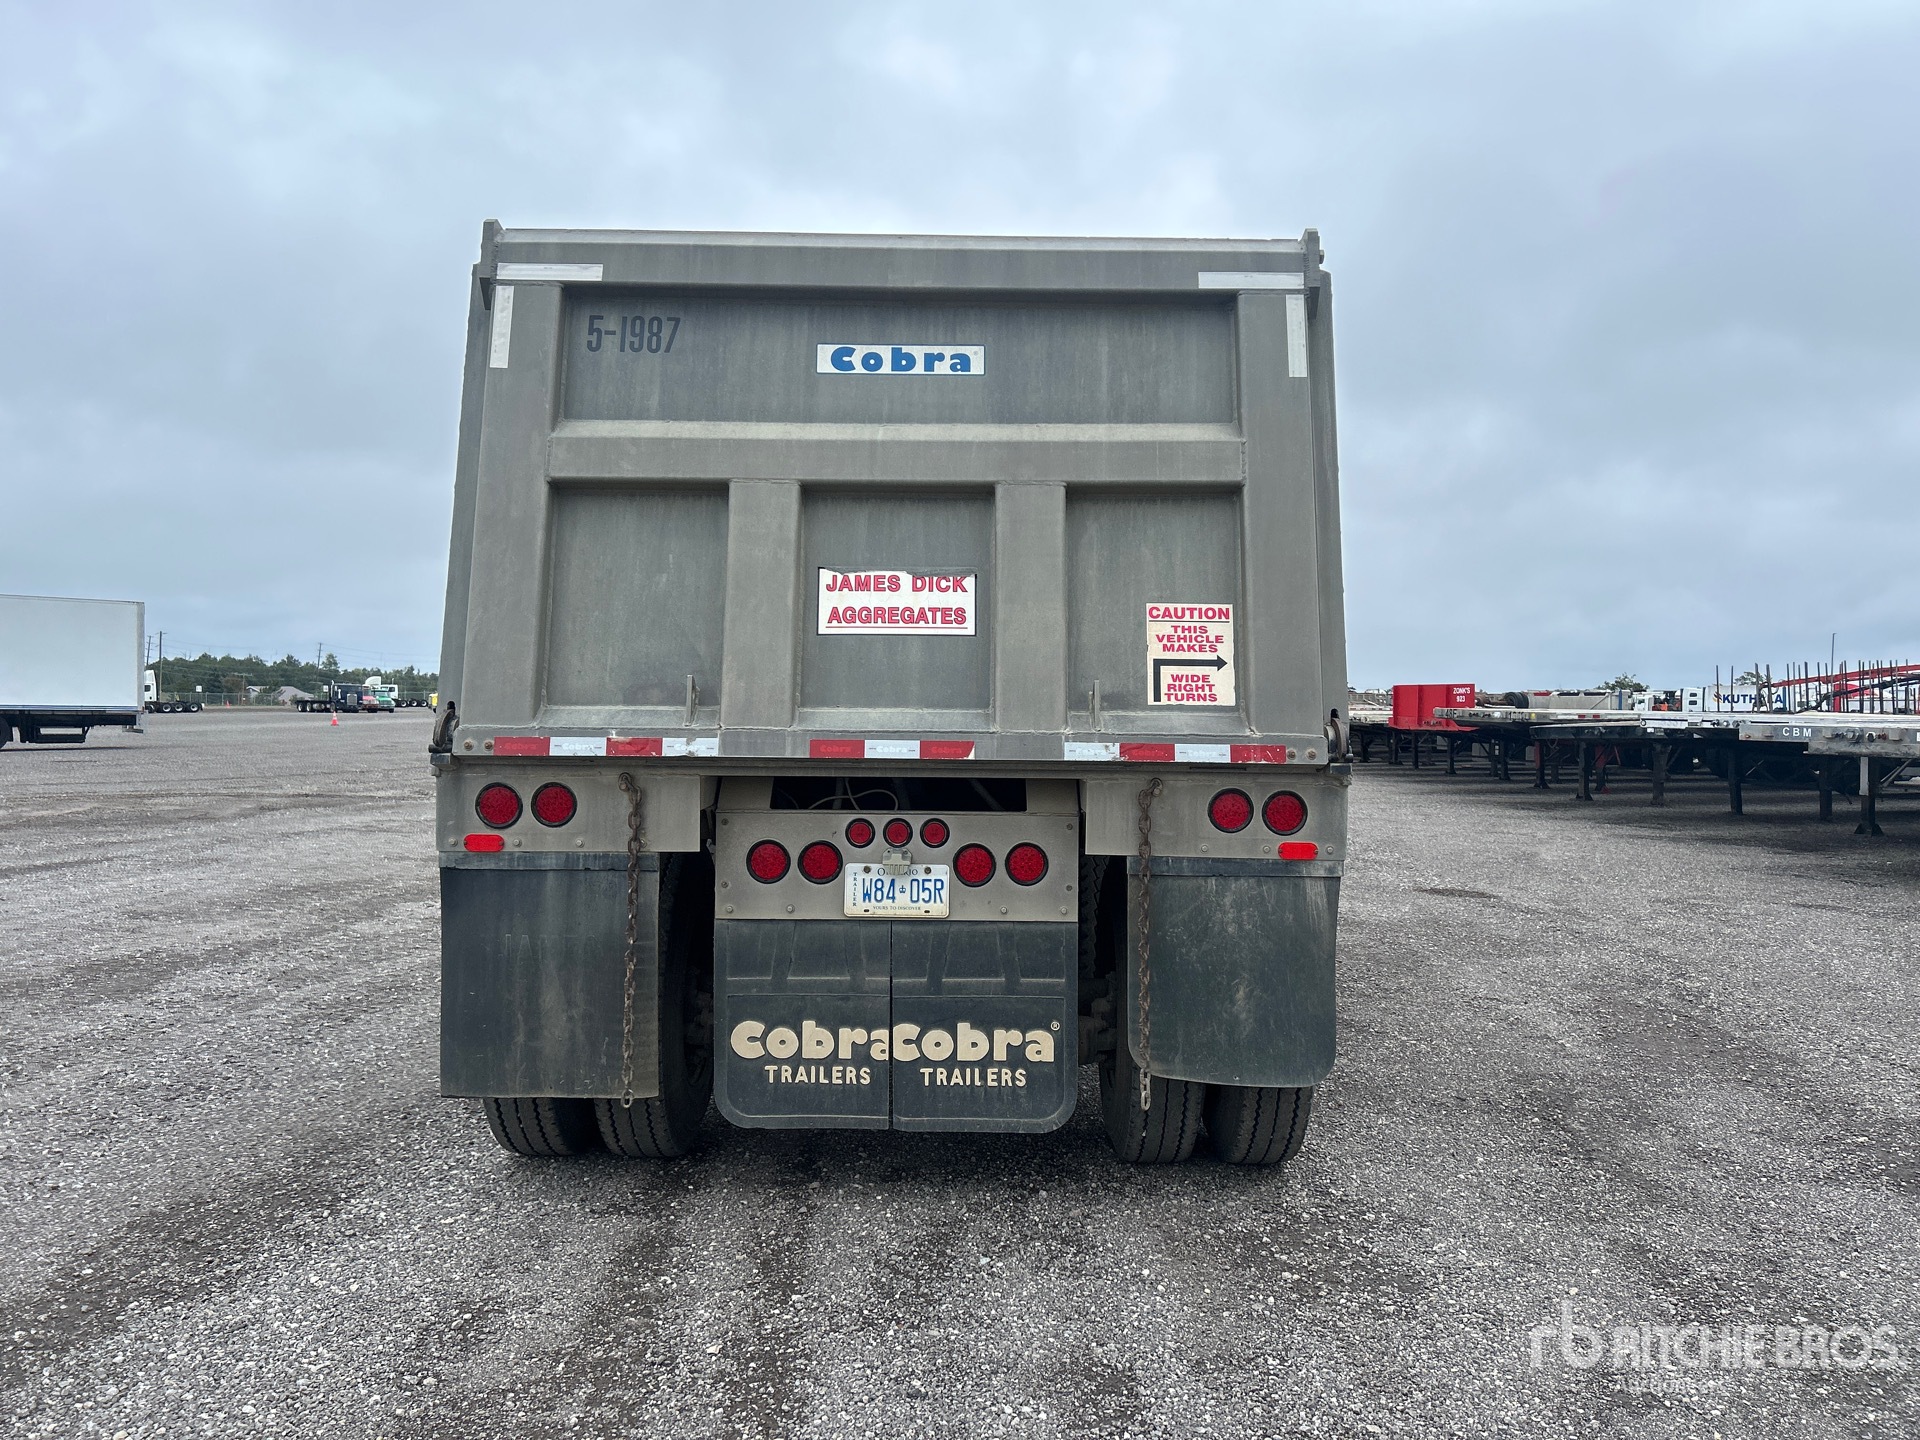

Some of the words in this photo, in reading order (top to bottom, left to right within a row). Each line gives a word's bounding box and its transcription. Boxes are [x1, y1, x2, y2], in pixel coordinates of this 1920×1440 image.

[586, 314, 681, 354] 5-1987
[830, 346, 972, 373] Cobra
[825, 574, 901, 593] JAMES
[911, 576, 968, 593] DICK
[827, 606, 967, 625] AGGREGATES
[1148, 606, 1230, 620] CAUTION
[1156, 634, 1224, 644] VEHICLE
[1171, 625, 1208, 634] THIS
[1162, 643, 1218, 653] MAKES
[1167, 683, 1215, 693] RIGHT
[1170, 674, 1211, 683] WIDE
[1164, 693, 1218, 702] TURNS
[1782, 727, 1812, 737] CBM
[862, 877, 896, 904] W84
[730, 1020, 889, 1060] Cobra
[892, 1022, 1055, 1062] Cobra
[764, 1065, 871, 1084] TRAILERS
[919, 1067, 1027, 1087] TRAILERS
